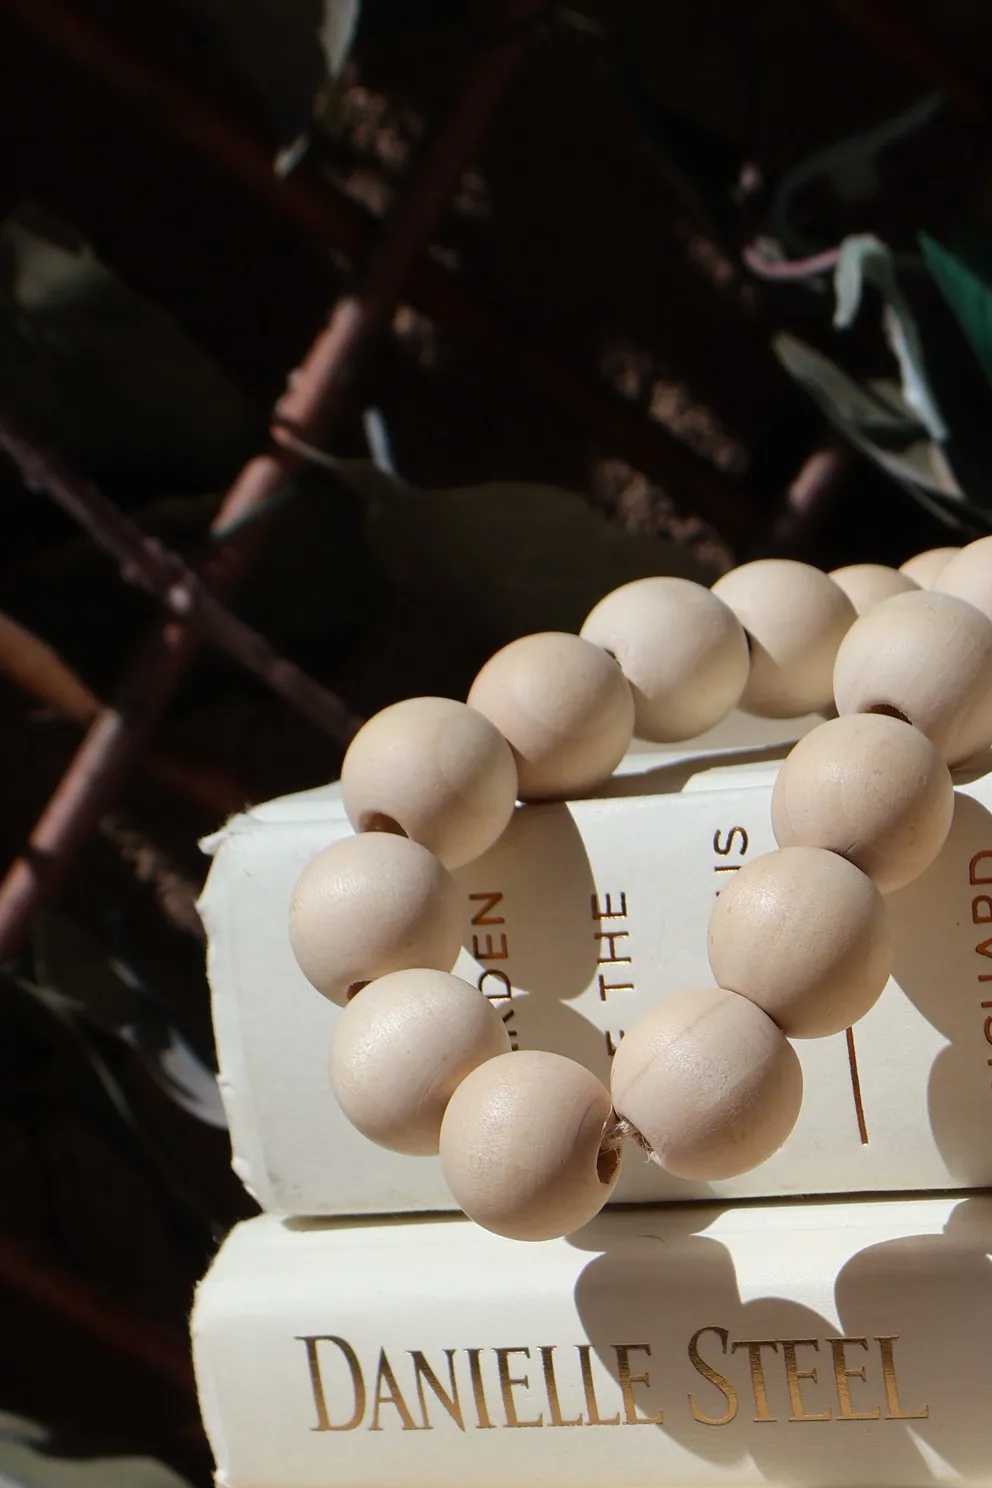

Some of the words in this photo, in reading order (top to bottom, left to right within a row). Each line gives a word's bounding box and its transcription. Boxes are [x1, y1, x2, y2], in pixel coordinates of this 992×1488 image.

[591, 890, 635, 1001] THE
[294, 1334, 664, 1432] DANIELLE
[687, 1325, 929, 1426] STEEL
